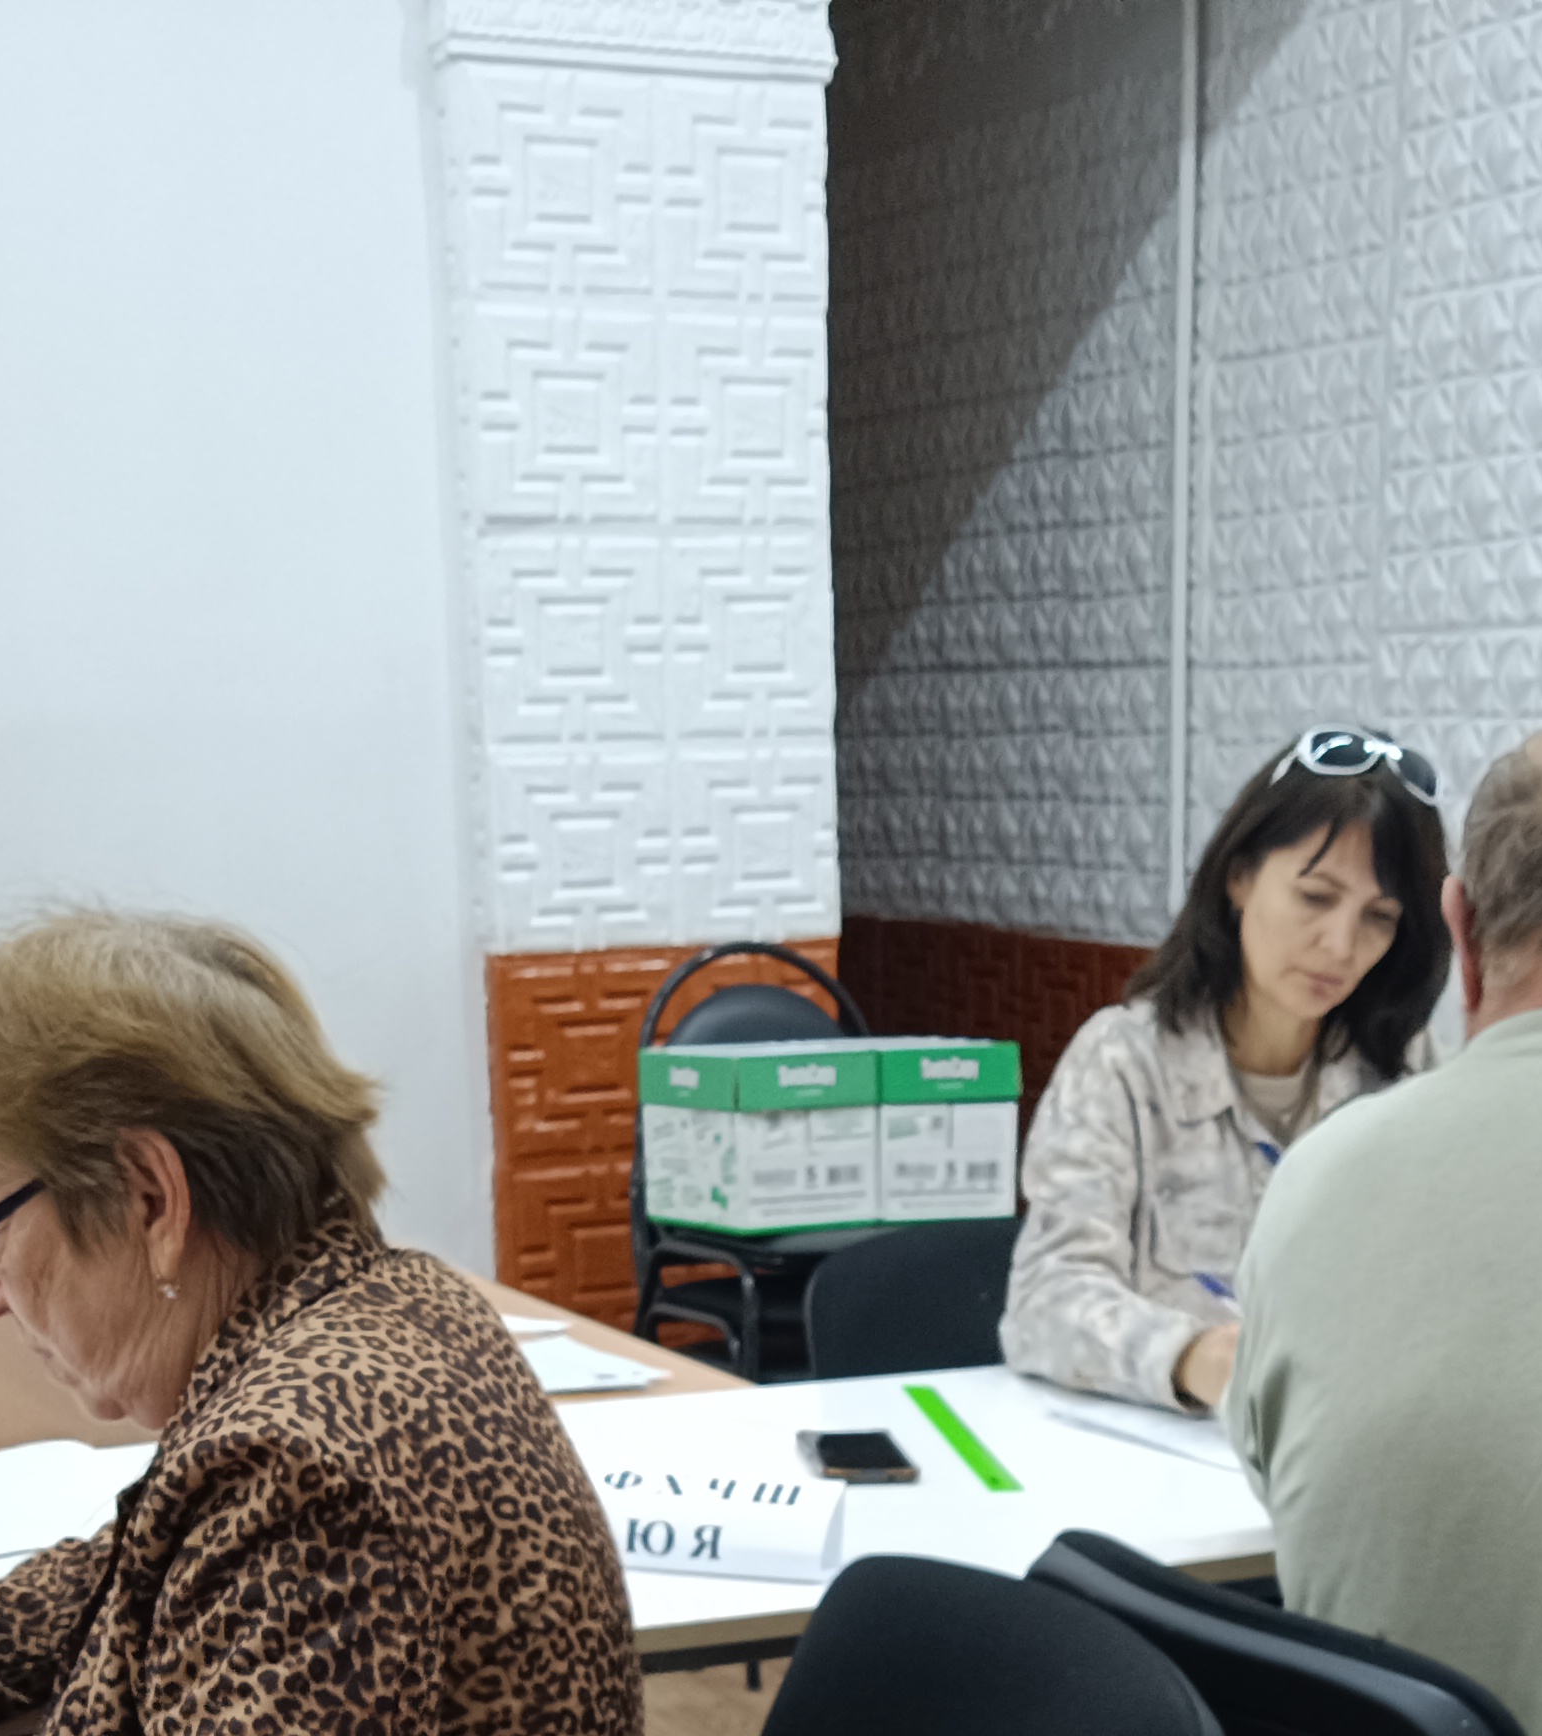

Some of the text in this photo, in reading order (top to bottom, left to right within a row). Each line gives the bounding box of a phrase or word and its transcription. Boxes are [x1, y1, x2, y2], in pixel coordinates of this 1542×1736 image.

[604, 1470, 643, 1489] Ф
[709, 1477, 736, 1500] Ч
[753, 1483, 801, 1505] Ш
[627, 1518, 723, 1560] Ю Я
